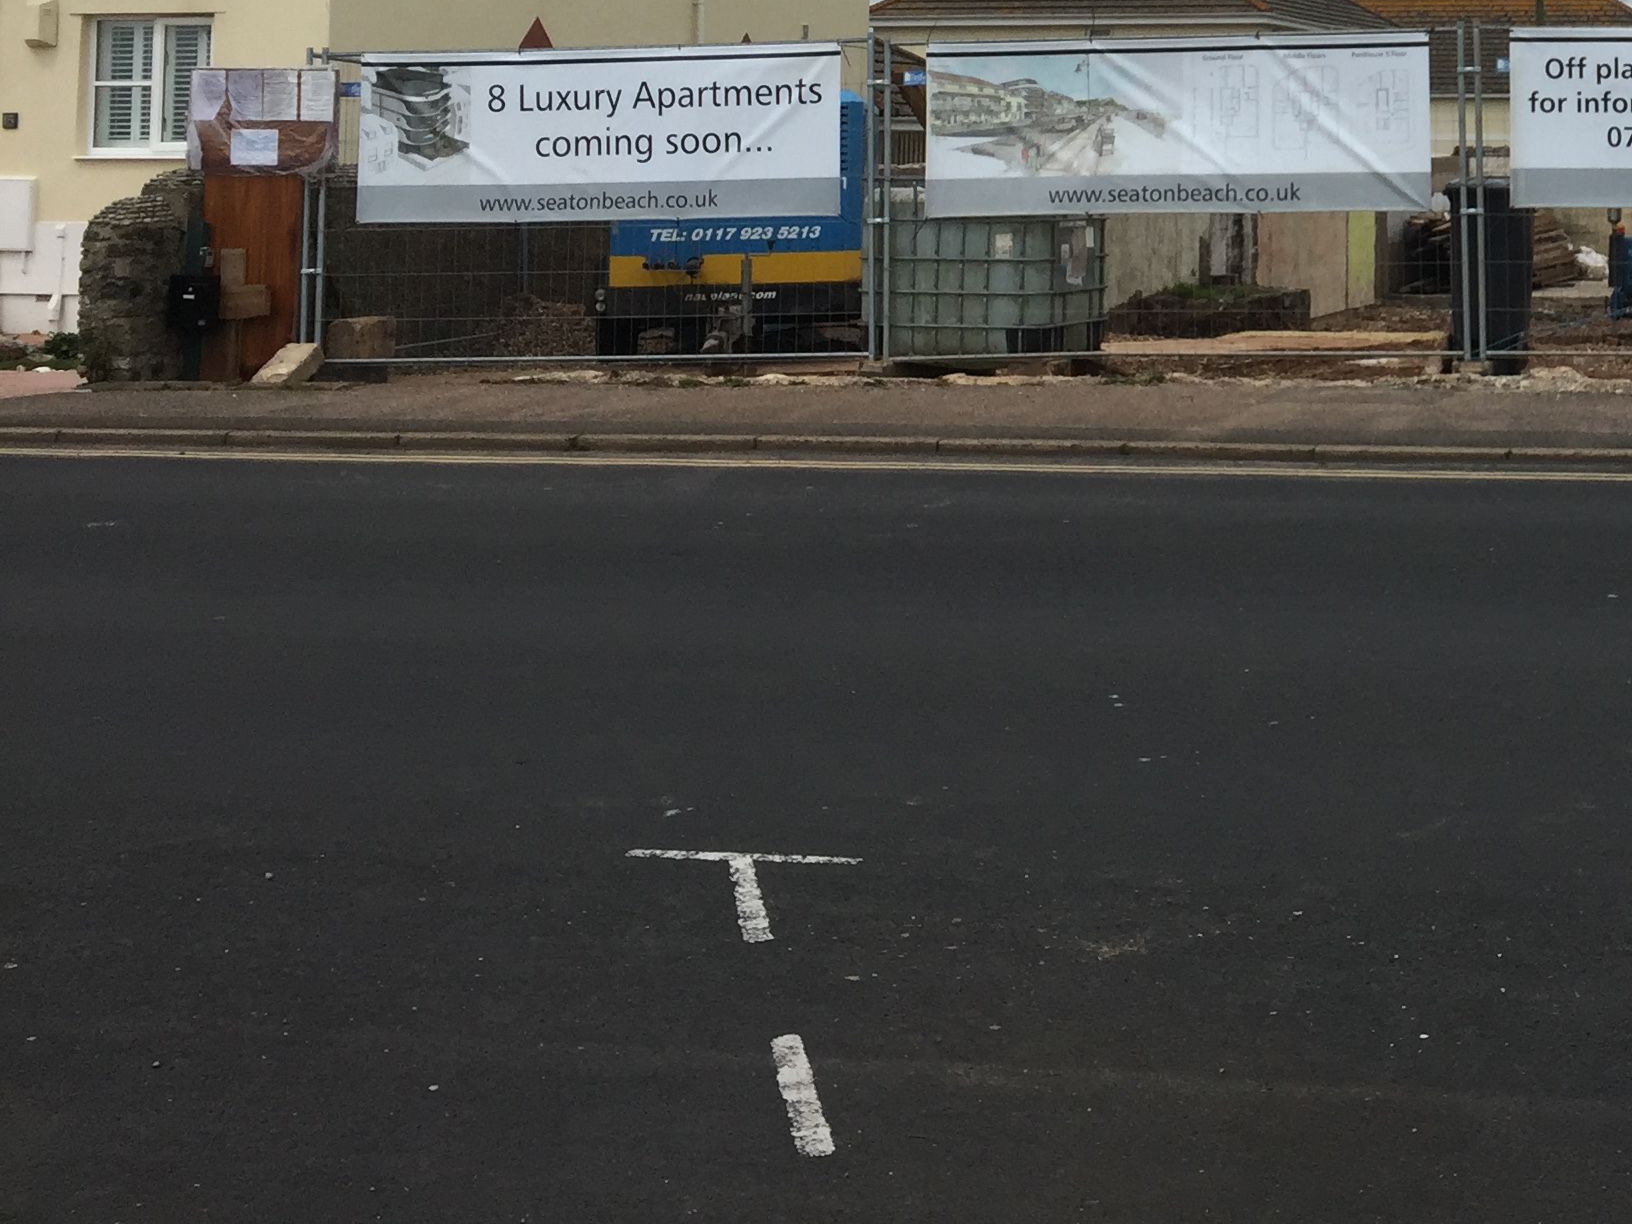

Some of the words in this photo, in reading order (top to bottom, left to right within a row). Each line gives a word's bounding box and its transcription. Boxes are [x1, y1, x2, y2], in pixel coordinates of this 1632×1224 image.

[1546, 57, 1586, 79] Off
[488, 85, 505, 112] 8
[520, 85, 621, 117] Luxury
[633, 79, 822, 116] Apartments
[1529, 91, 1567, 113] for
[536, 127, 652, 163] coming
[666, 132, 772, 154] soon...
[480, 189, 717, 211] www.seatonbeach.co.uk
[1049, 182, 1300, 203] www.seatonbeach.co.uk
[651, 229, 686, 241] TEL:
[692, 228, 737, 240] 0117
[740, 227, 773, 239] 923
[777, 226, 821, 238] 5213
